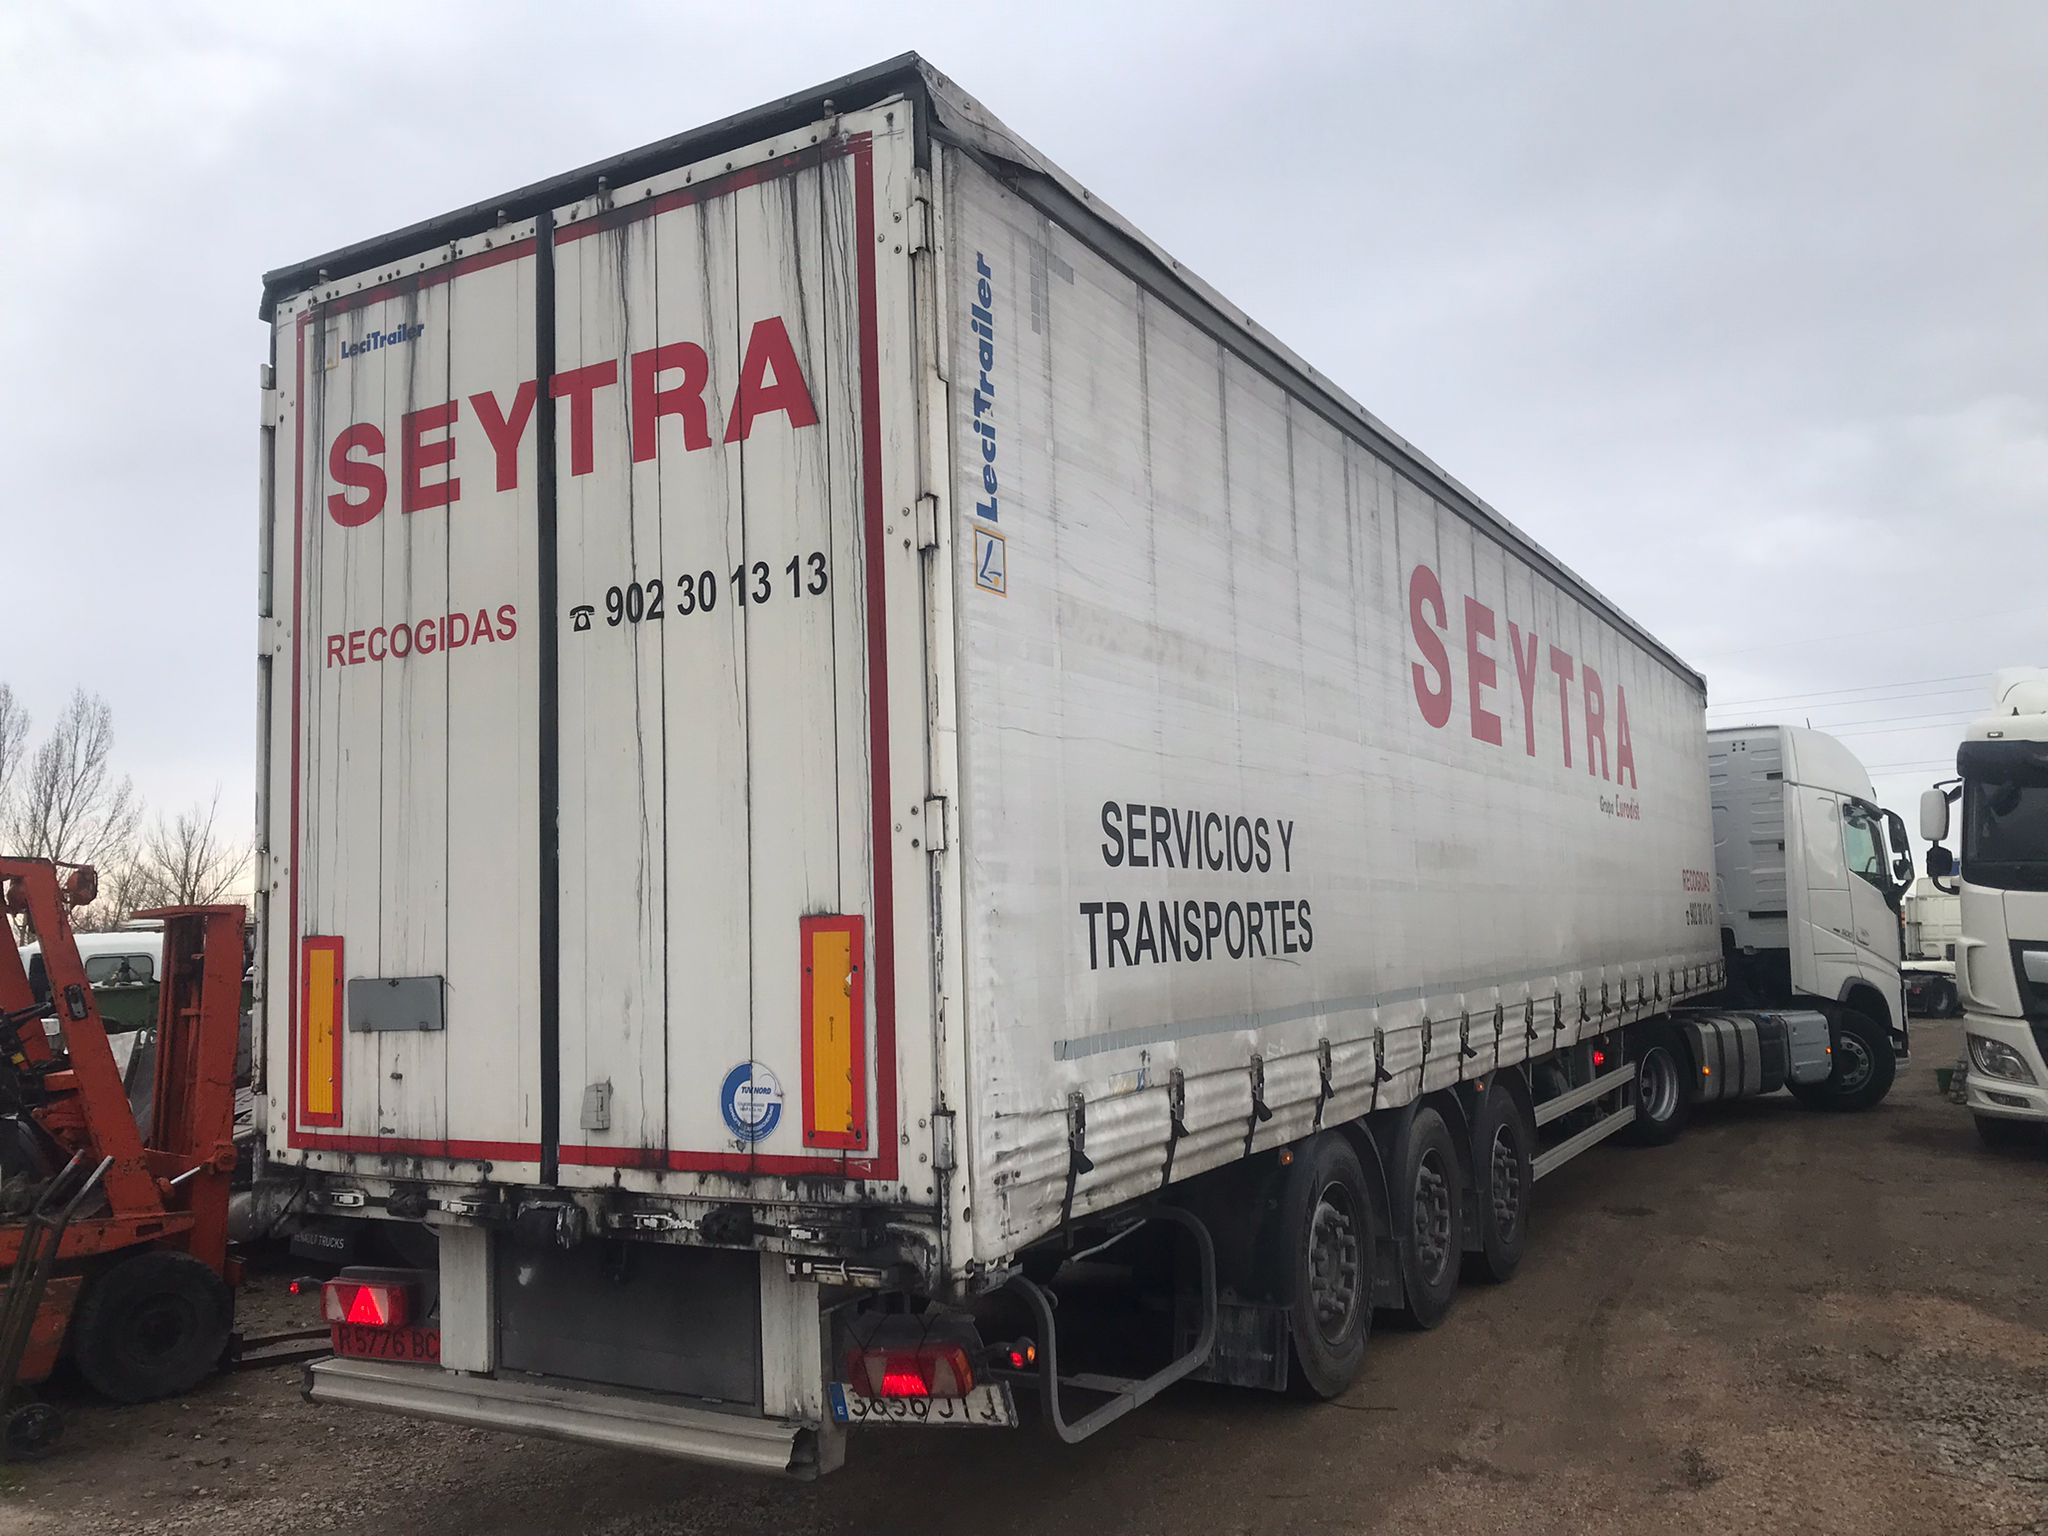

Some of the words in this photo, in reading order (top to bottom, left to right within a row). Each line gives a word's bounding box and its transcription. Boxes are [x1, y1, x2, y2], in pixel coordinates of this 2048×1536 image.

[341, 322, 425, 359] LeciTrailer
[327, 315, 821, 528] SEYTRA
[972, 251, 998, 523] LeciTrailer
[605, 582, 665, 628] 902
[677, 570, 717, 617] 30
[730, 561, 772, 607] 13
[785, 551, 829, 599] 13
[327, 604, 517, 669] RECOGIDAS
[1408, 564, 1638, 790] SEYTRA
[1101, 800, 1271, 873] SERVICIOS
[1276, 819, 1294, 873] Y
[1079, 898, 1313, 970] TRANSPORTES
